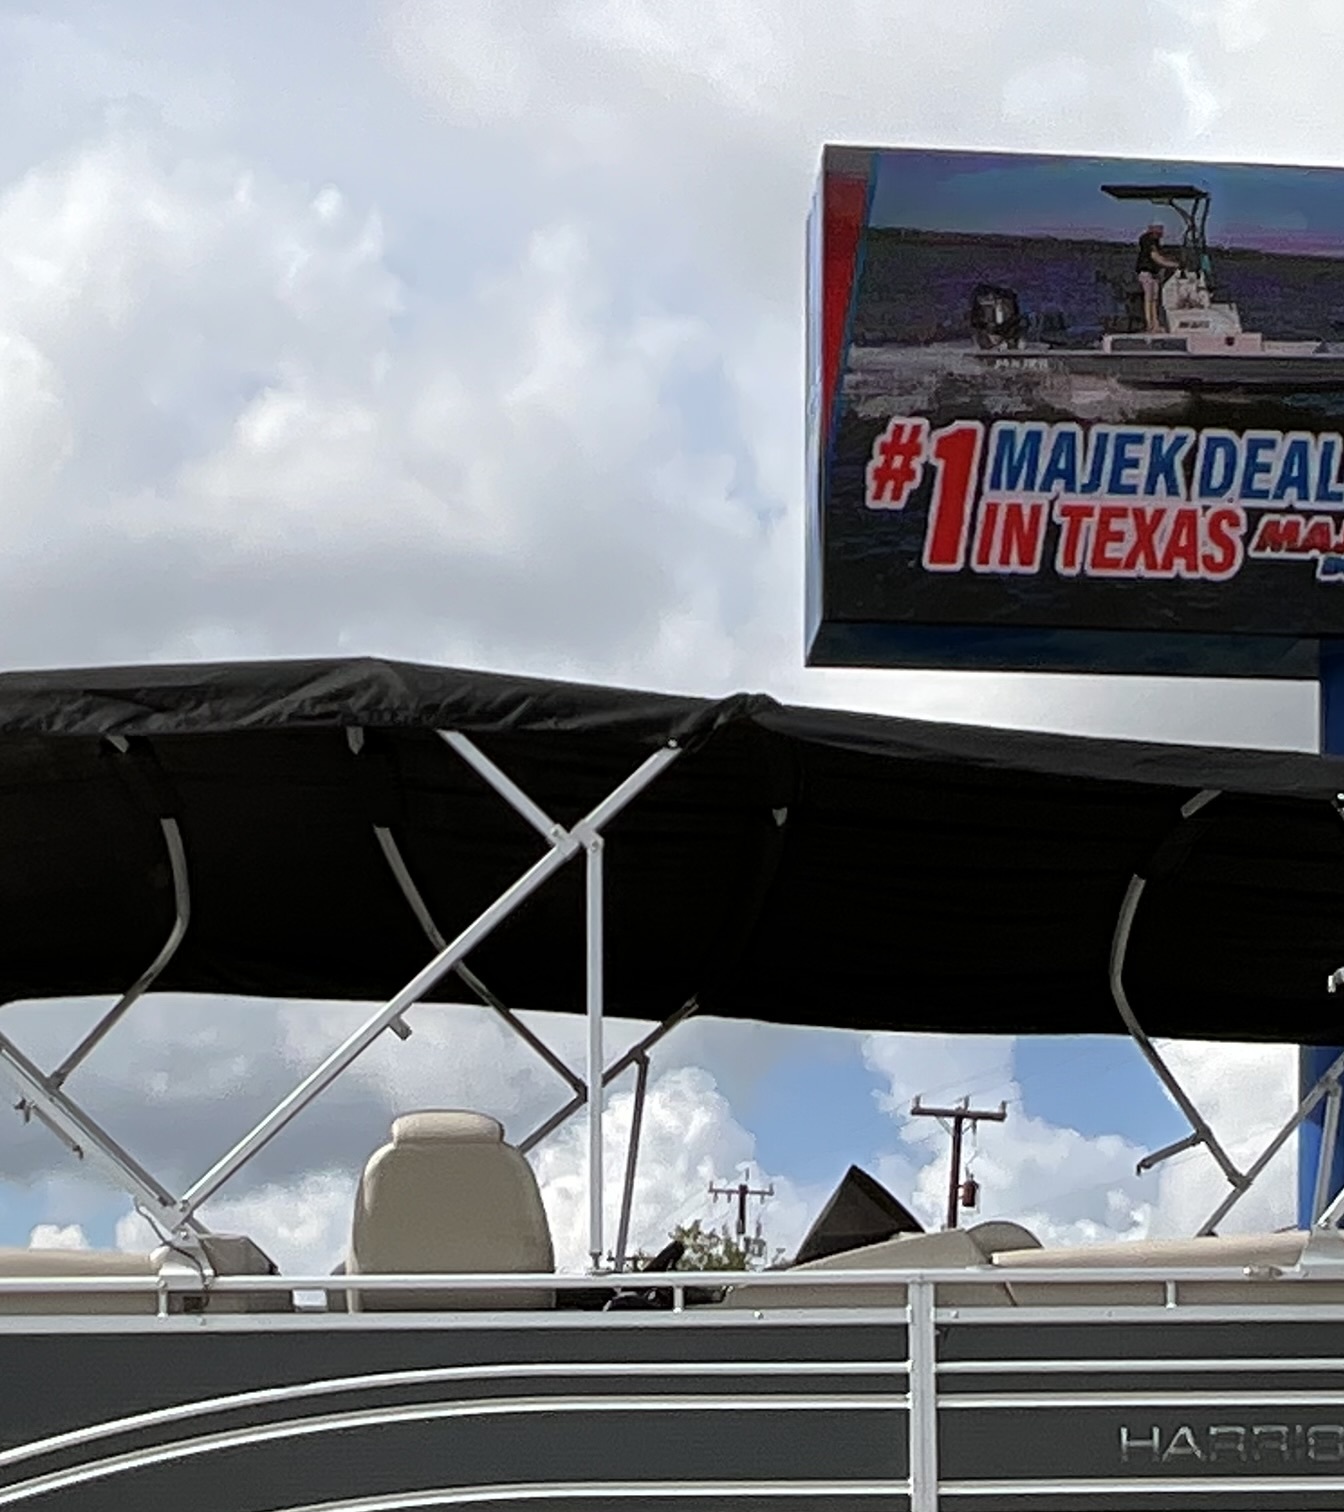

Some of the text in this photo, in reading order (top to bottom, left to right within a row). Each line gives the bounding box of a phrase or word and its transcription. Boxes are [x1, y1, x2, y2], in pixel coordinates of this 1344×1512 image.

[872, 422, 980, 567] #1
[990, 428, 1189, 497] MAJEK
[977, 502, 1242, 574] IN TEXAS
